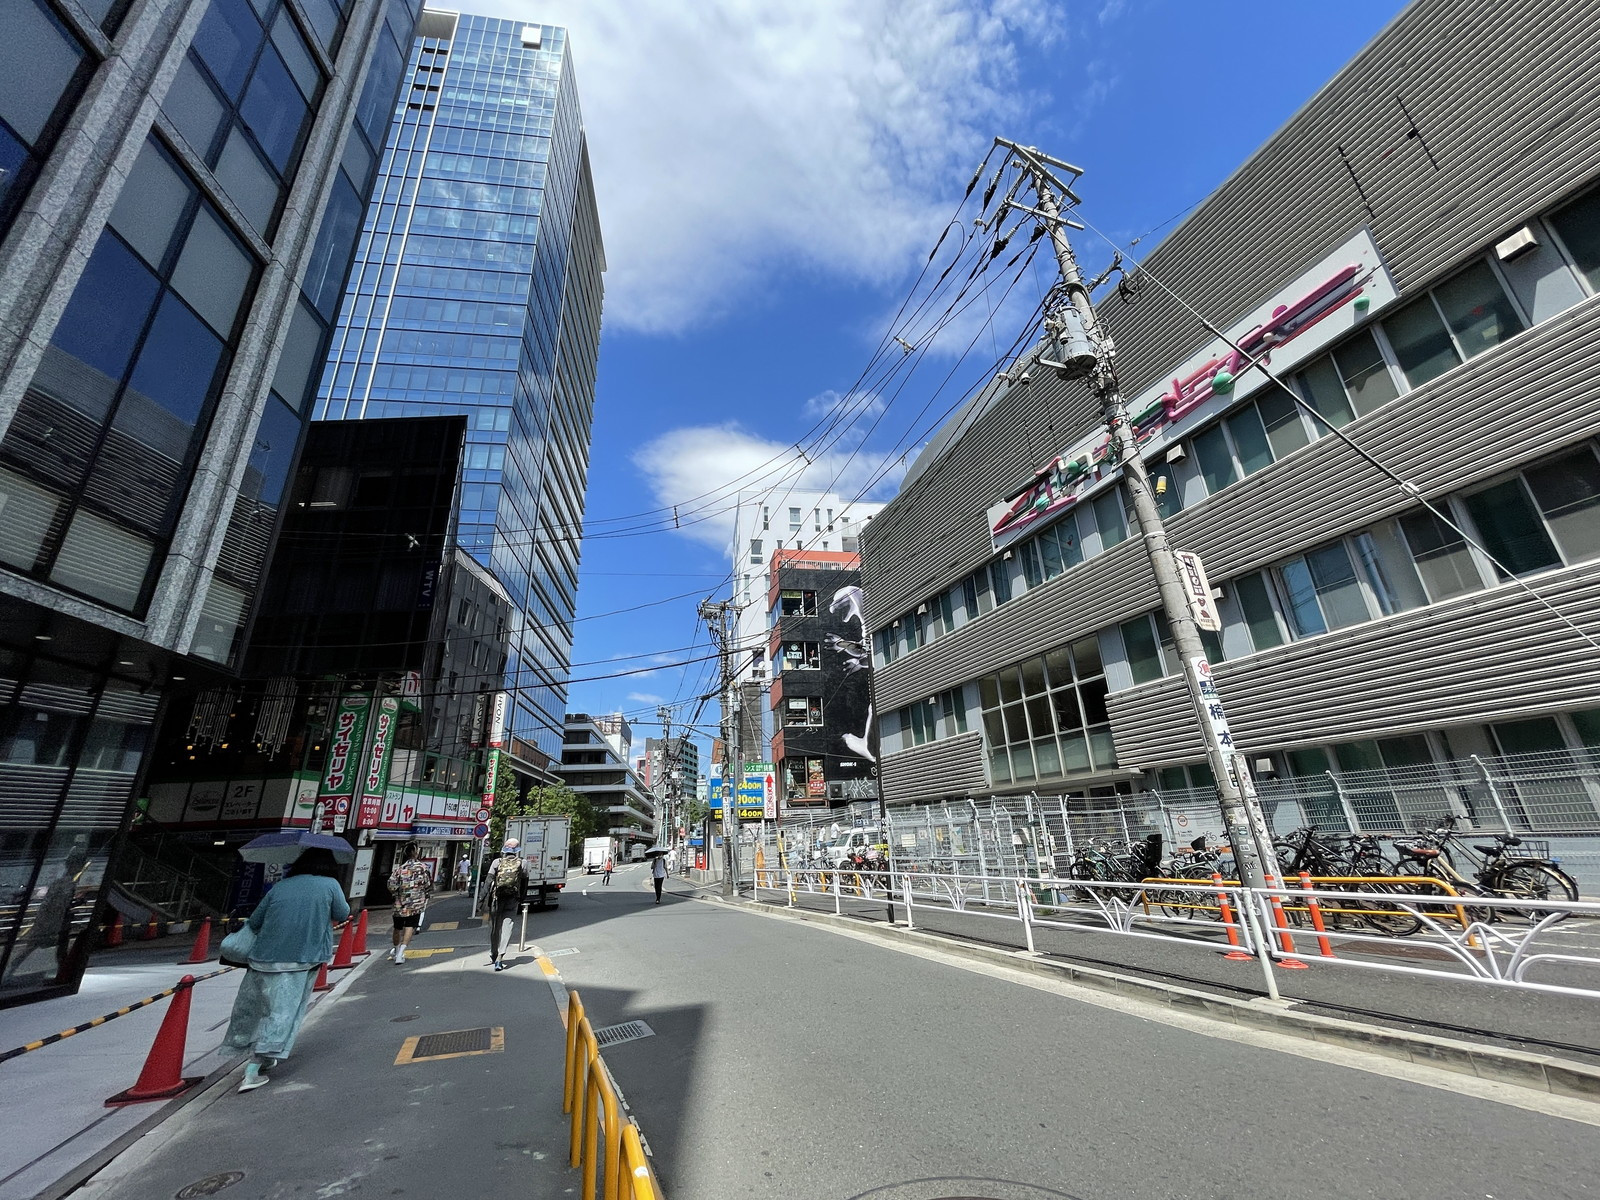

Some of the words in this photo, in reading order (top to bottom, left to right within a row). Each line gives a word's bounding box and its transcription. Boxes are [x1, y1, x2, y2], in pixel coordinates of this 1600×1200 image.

[422, 570, 434, 597] WTV
[495, 695, 503, 723] NOAH
[1209, 703, 1233, 747] 楠本
[325, 711, 357, 791] サイゼリヤ
[368, 714, 390, 791] サイゼリヤ
[486, 758, 496, 791] サイゼリヤ
[233, 786, 255, 797] 2F
[478, 811, 487, 819] 30
[430, 827, 451, 835] LAWSON
